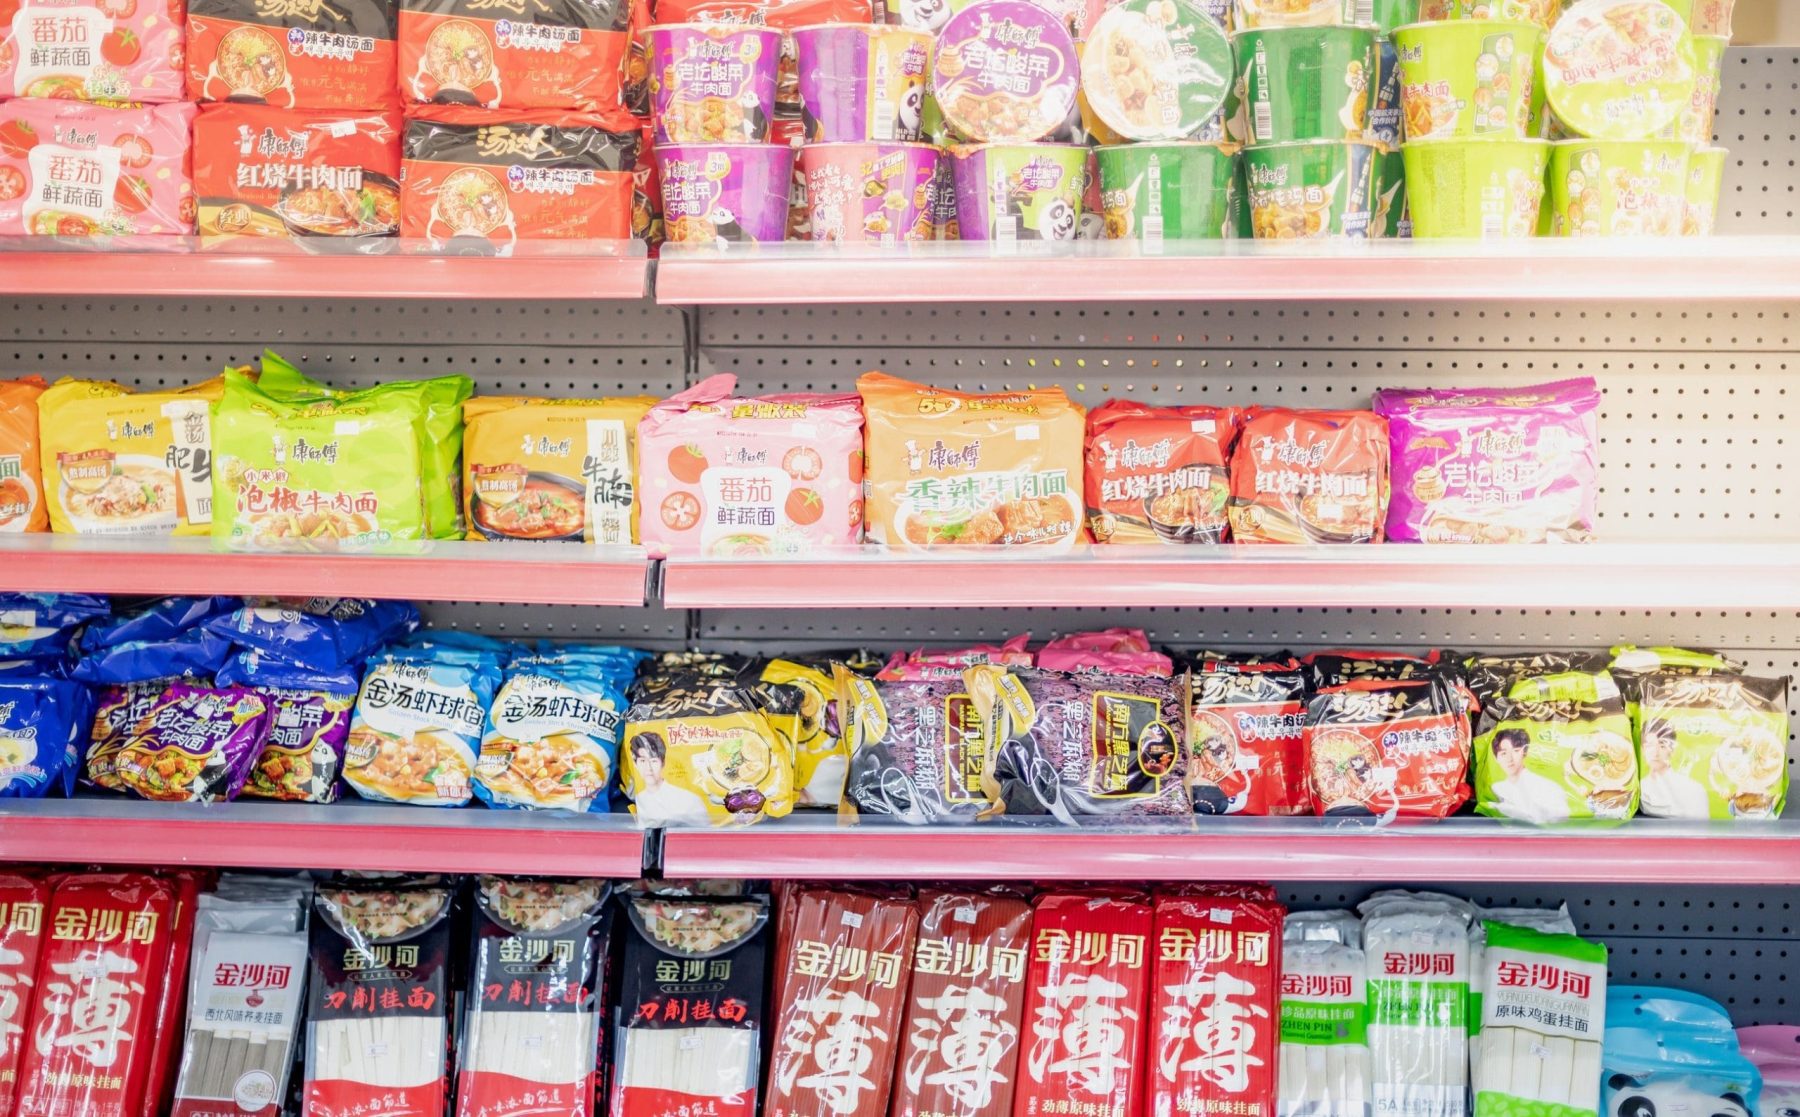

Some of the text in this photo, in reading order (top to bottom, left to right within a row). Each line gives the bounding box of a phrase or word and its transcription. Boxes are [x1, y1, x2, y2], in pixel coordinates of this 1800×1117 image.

[31, 17, 88, 43] 番茄
[305, 31, 375, 52] 辣牛肉汤面
[511, 24, 582, 43] 辣牛肉汤面
[30, 47, 91, 67] 鲜蔬面
[678, 62, 744, 82] 老坛酸菜
[690, 82, 732, 96] 牛肉面
[49, 155, 102, 185] 番茄
[236, 162, 362, 191] 红烧牛肉面
[525, 168, 593, 185] 辣牛肉汤面
[42, 184, 103, 208] 鲜蔬面
[670, 202, 700, 216] 牛肉面
[293, 438, 338, 463] 康師傅
[928, 441, 982, 471] 康師傅
[719, 477, 773, 503] 番茄
[908, 470, 1067, 513] 香辣牛肉面
[1101, 466, 1210, 502] 红烧牛肉面
[1256, 465, 1368, 497] 红烧牛肉面
[237, 485, 379, 515] 泡椒牛肉面
[1465, 490, 1522, 505] 牛肉面
[717, 506, 775, 527] 鲜蔬面
[365, 676, 484, 724] 金汤虾球面
[502, 695, 621, 730] 金汤虾球面
[158, 708, 233, 742] 老坛酸菜
[160, 728, 206, 751] 牛肉面
[915, 705, 937, 790] 黑芝麻糊
[1062, 701, 1085, 781] 黑芝麻糊
[1109, 704, 1131, 790] 南方黑芝麻
[51, 908, 159, 945] 金沙河
[343, 945, 420, 970] 金沙河
[500, 939, 576, 963] 金沙河
[914, 938, 1027, 983] 金沙河
[1034, 928, 1146, 969] 金沙河
[1159, 927, 1269, 967] 金沙河
[213, 963, 292, 990] 金沙河
[655, 959, 732, 982] 金沙河
[795, 940, 904, 989] 金沙河
[1384, 952, 1456, 977] 金沙河
[482, 981, 588, 1007] 刀削挂面
[1281, 974, 1353, 997] 金沙河
[1498, 961, 1590, 1000] 金沙河
[36, 948, 146, 1067] 薄
[323, 985, 436, 1013] 刀削挂面
[638, 998, 748, 1024] 刀削挂面
[1281, 1006, 1355, 1019] 珍品原味挂面
[205, 1008, 285, 1026] 西北风味荞麦挂面
[1281, 1020, 1333, 1031] ZHEN PIN
[1495, 1004, 1590, 1034] 原味鸡蛋挂面
[1030, 972, 1139, 1098] 薄
[1160, 972, 1268, 1093] 薄
[781, 988, 889, 1115] 薄
[905, 985, 1018, 1110] 薄
